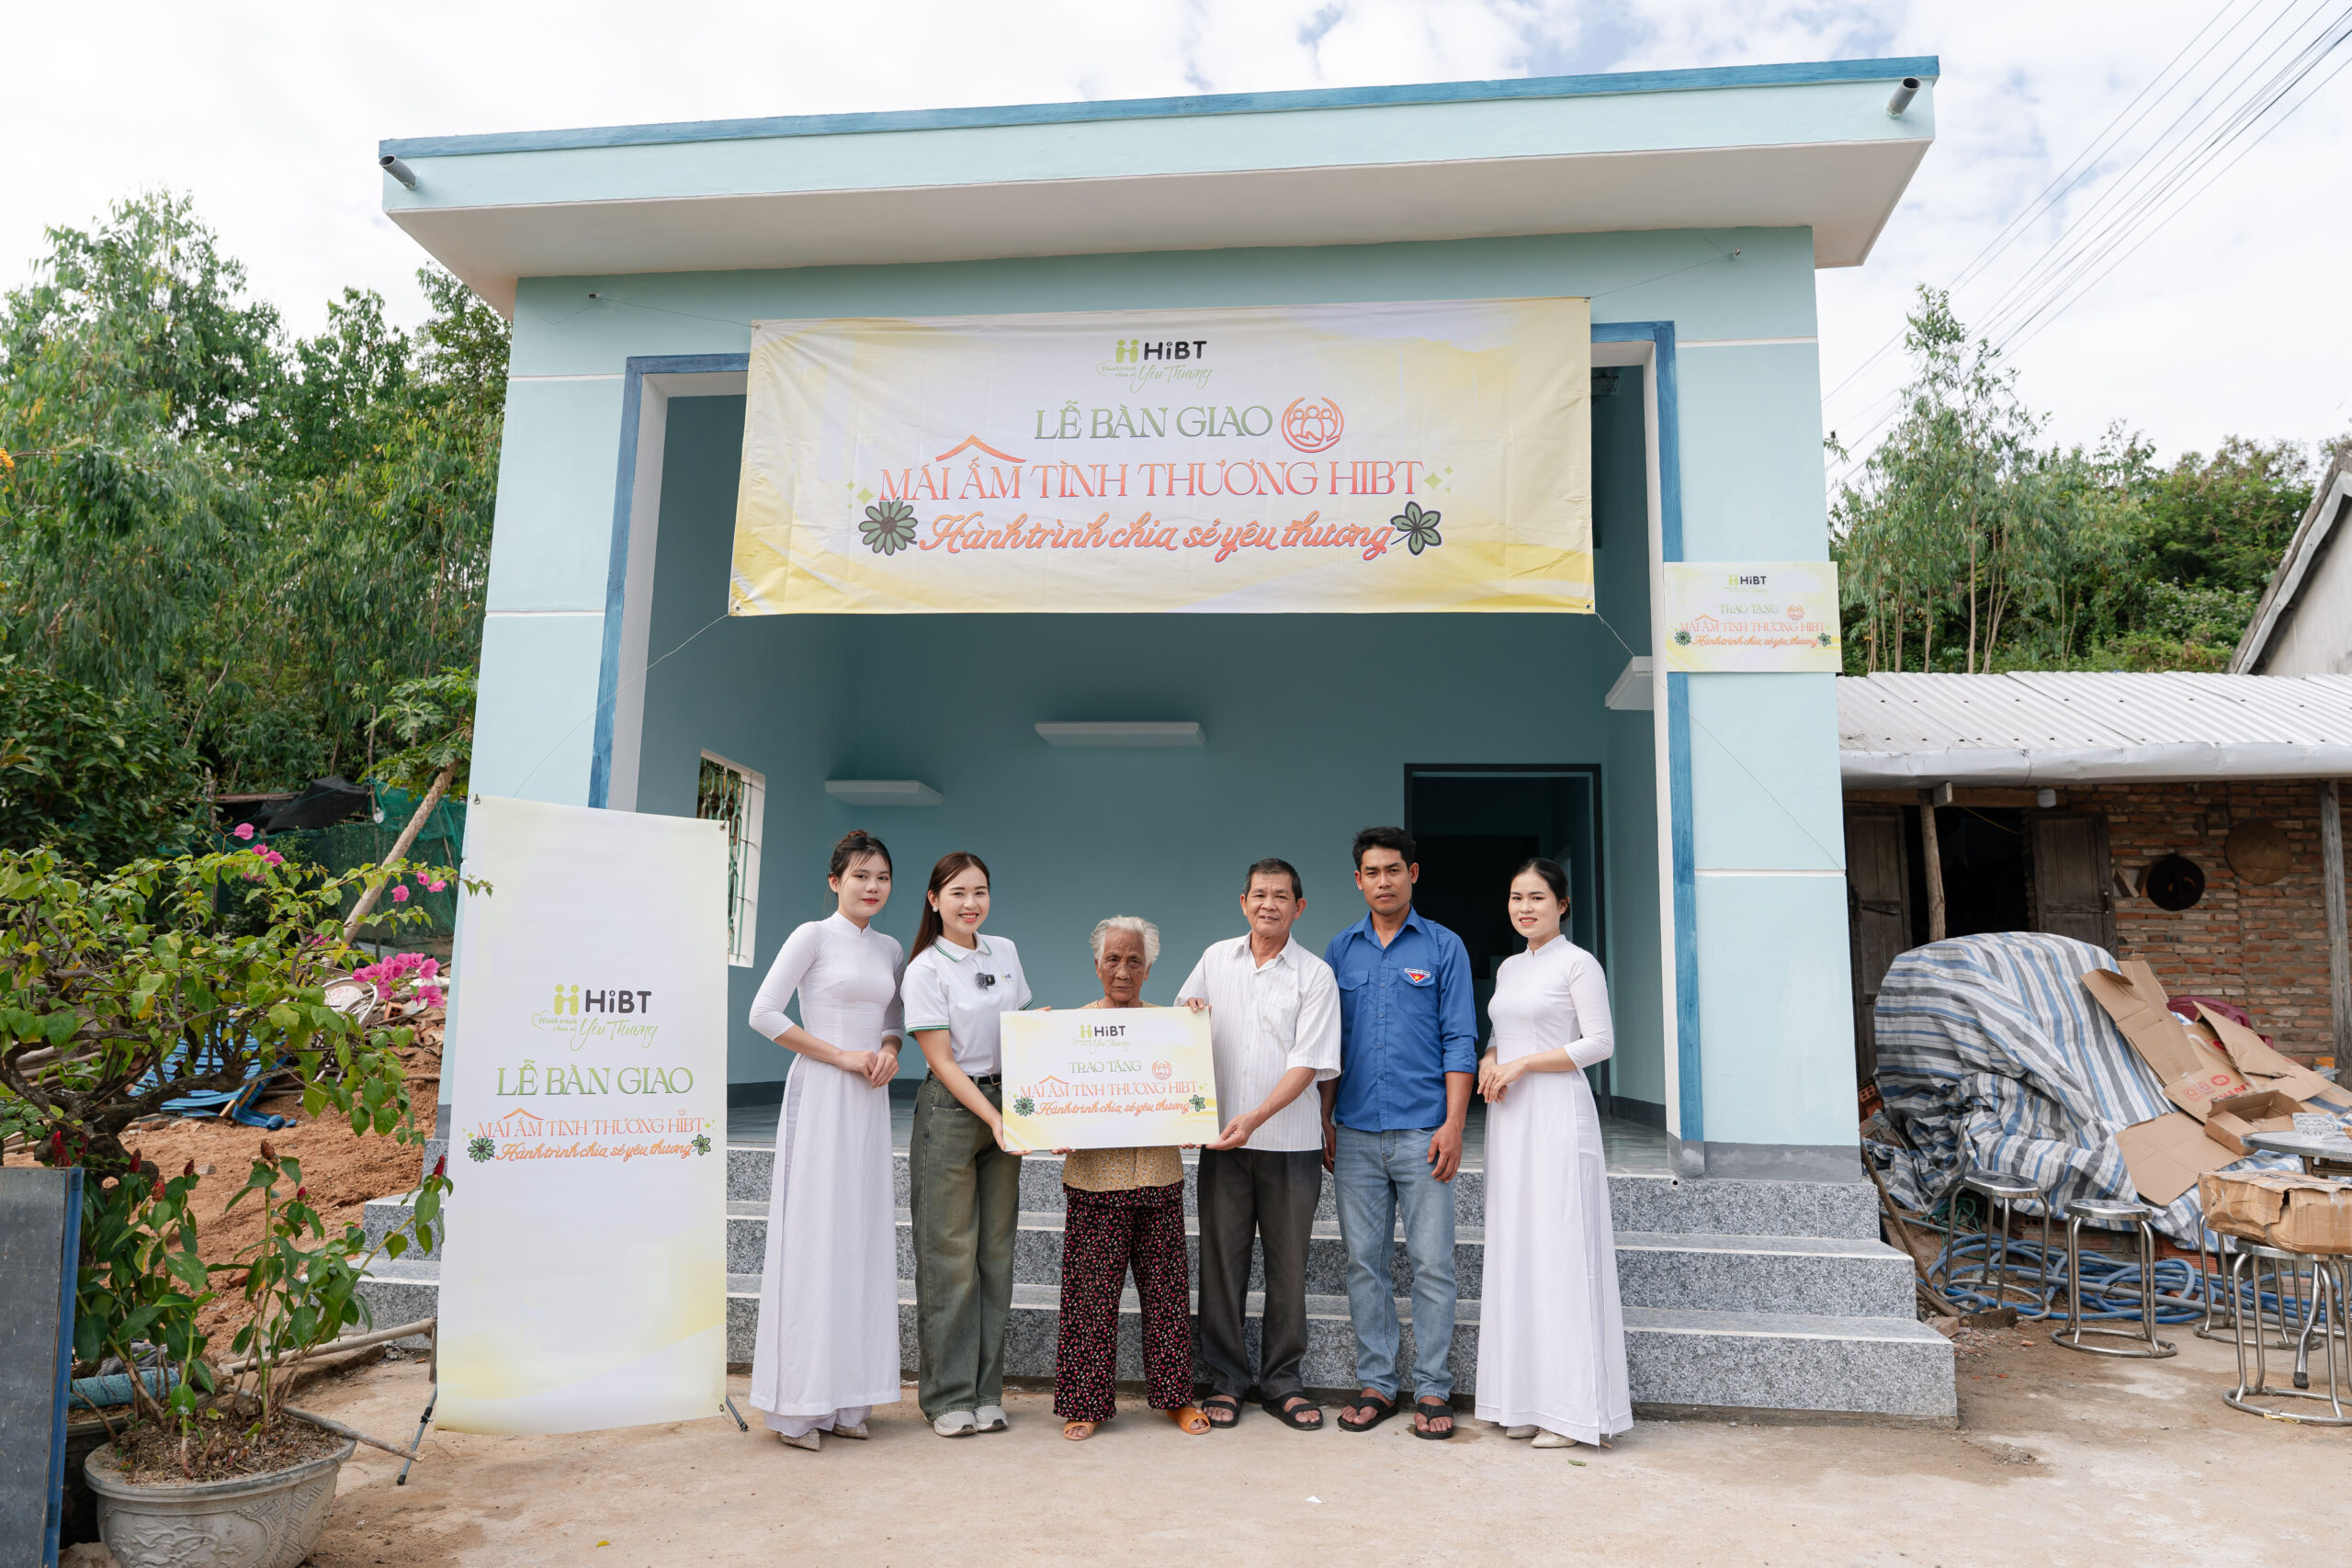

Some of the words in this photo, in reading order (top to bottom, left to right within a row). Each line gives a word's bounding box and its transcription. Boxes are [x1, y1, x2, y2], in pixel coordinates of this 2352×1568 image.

[1144, 341, 1207, 360] HiBT
[1034, 400, 1082, 439] LỄ
[1090, 403, 1169, 438] BÀN
[1176, 405, 1273, 437] GIAO
[878, 463, 950, 501] MÁI
[958, 456, 1023, 499] ẤM
[1030, 459, 1129, 499] TÌNH
[1136, 458, 1318, 497] THƯƠNG
[1329, 461, 1425, 495] HIBT
[919, 511, 1028, 554] Hành
[1025, 512, 1110, 549] trình
[1108, 511, 1179, 551] chia
[1182, 517, 1222, 548] sẻ
[1214, 518, 1279, 562] yêu
[1281, 510, 1395, 561] thương
[585, 989, 652, 1013] HiBT
[496, 1059, 538, 1095] LỄ
[545, 1064, 611, 1095] BÀN
[617, 1066, 694, 1095] GIAO
[1069, 1061, 1104, 1073] TRAO
[1020, 1084, 1045, 1098] MÁI
[1072, 1083, 1104, 1096] TÌNH
[1169, 1080, 1198, 1094] HIBT
[1100, 1100, 1122, 1113] chia
[477, 1120, 510, 1138] MÁI
[514, 1117, 543, 1137] ẤM
[546, 1118, 588, 1136] TÌNH
[592, 1117, 664, 1135] THƯƠNG
[668, 1117, 705, 1133] HIBT
[496, 1142, 546, 1161] Hành
[544, 1142, 581, 1158] trình
[580, 1141, 608, 1157] chia
[623, 1142, 649, 1162] yêu
